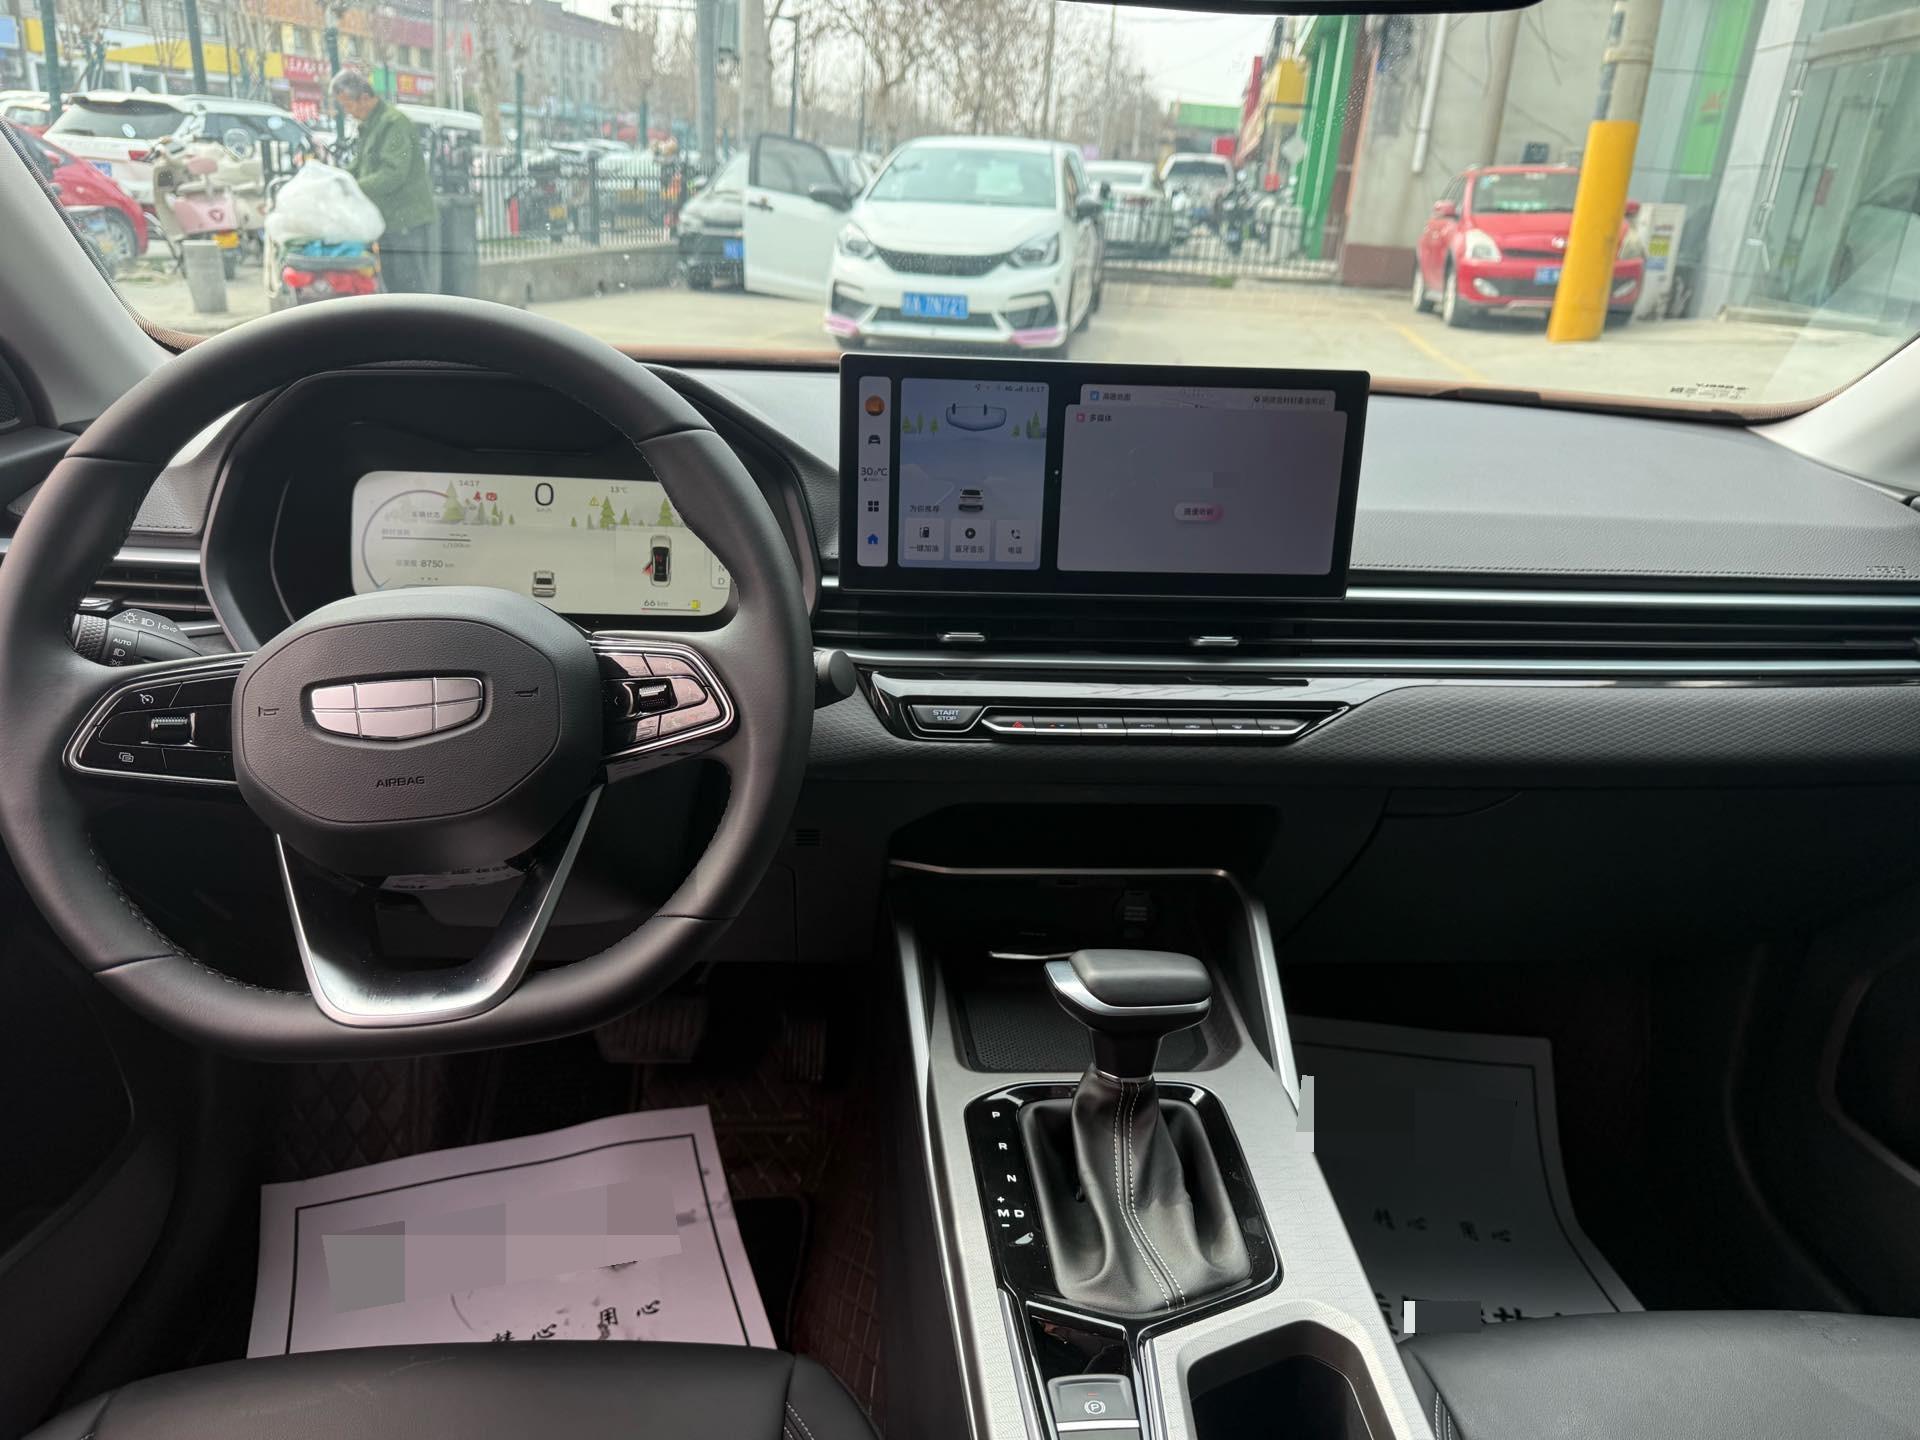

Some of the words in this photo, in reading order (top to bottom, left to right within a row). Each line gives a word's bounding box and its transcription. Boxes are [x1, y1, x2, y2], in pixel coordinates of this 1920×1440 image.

[535, 482, 554, 506] 0
[420, 559, 443, 568] 8750
[113, 637, 132, 646] AUTO
[376, 776, 425, 788] AIRBAG
[991, 1111, 1001, 1119] P
[998, 1142, 1008, 1151] R
[1006, 1174, 1017, 1183] N
[997, 1209, 1010, 1218] M
[1014, 1209, 1025, 1218] D
